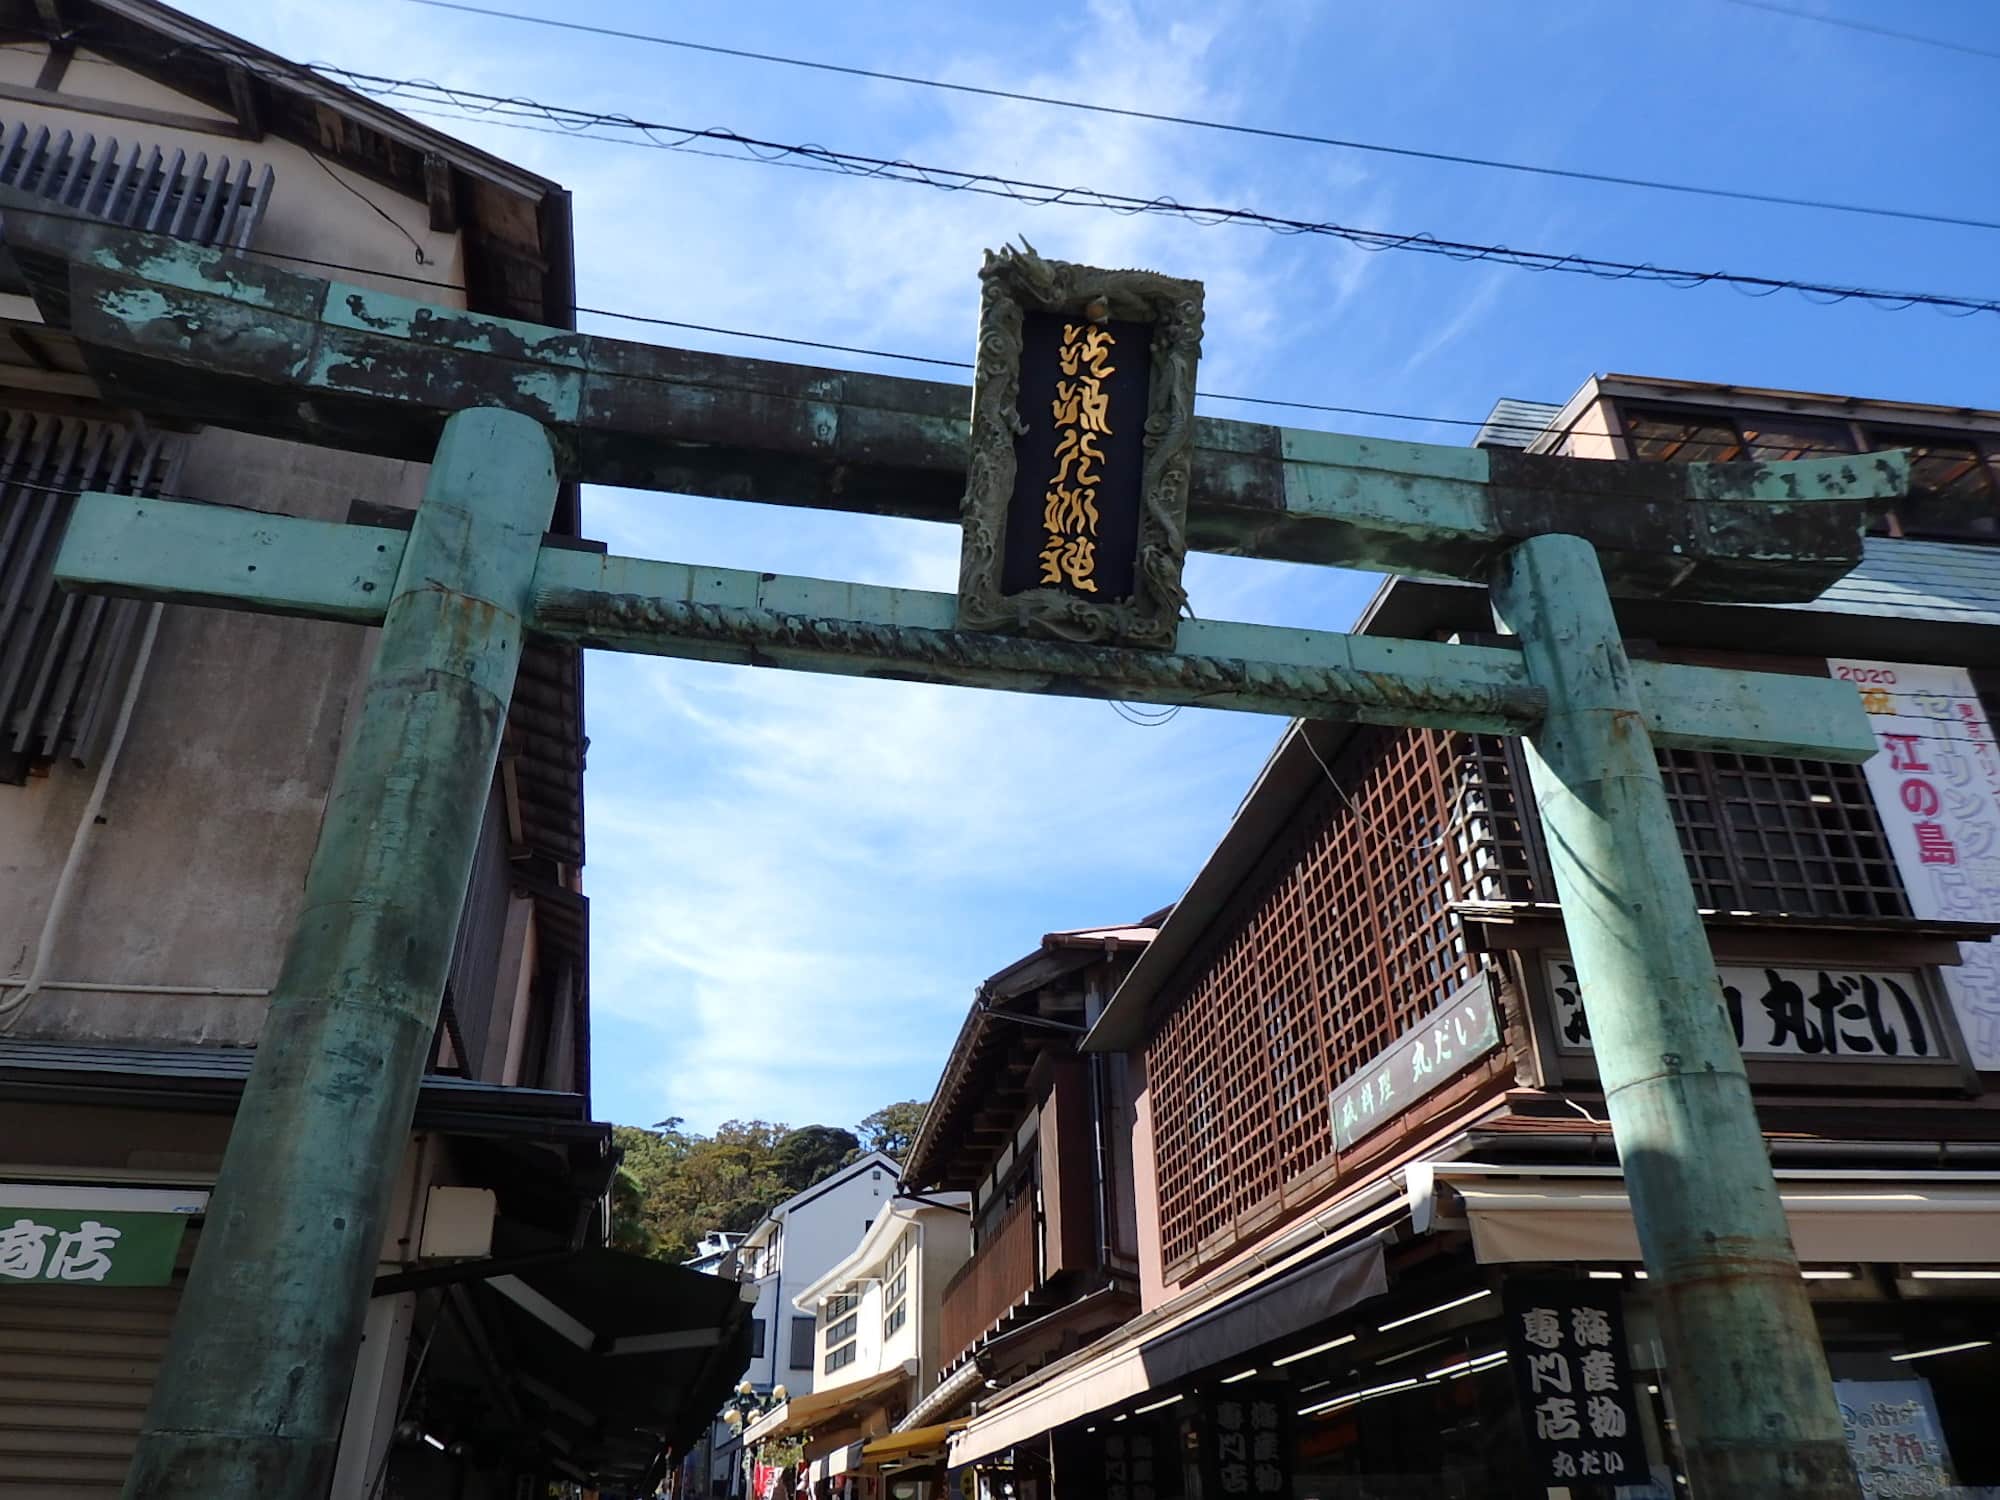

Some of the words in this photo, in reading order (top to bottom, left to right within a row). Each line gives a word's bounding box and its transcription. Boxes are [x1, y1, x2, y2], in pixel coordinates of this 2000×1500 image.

[1837, 666, 1896, 686] 2020
[1412, 1007, 1476, 1083] 丸だい
[0, 1219, 122, 1282] 商店
[1570, 1306, 1627, 1439] 海産物
[1551, 1450, 1625, 1478] 丸だい
